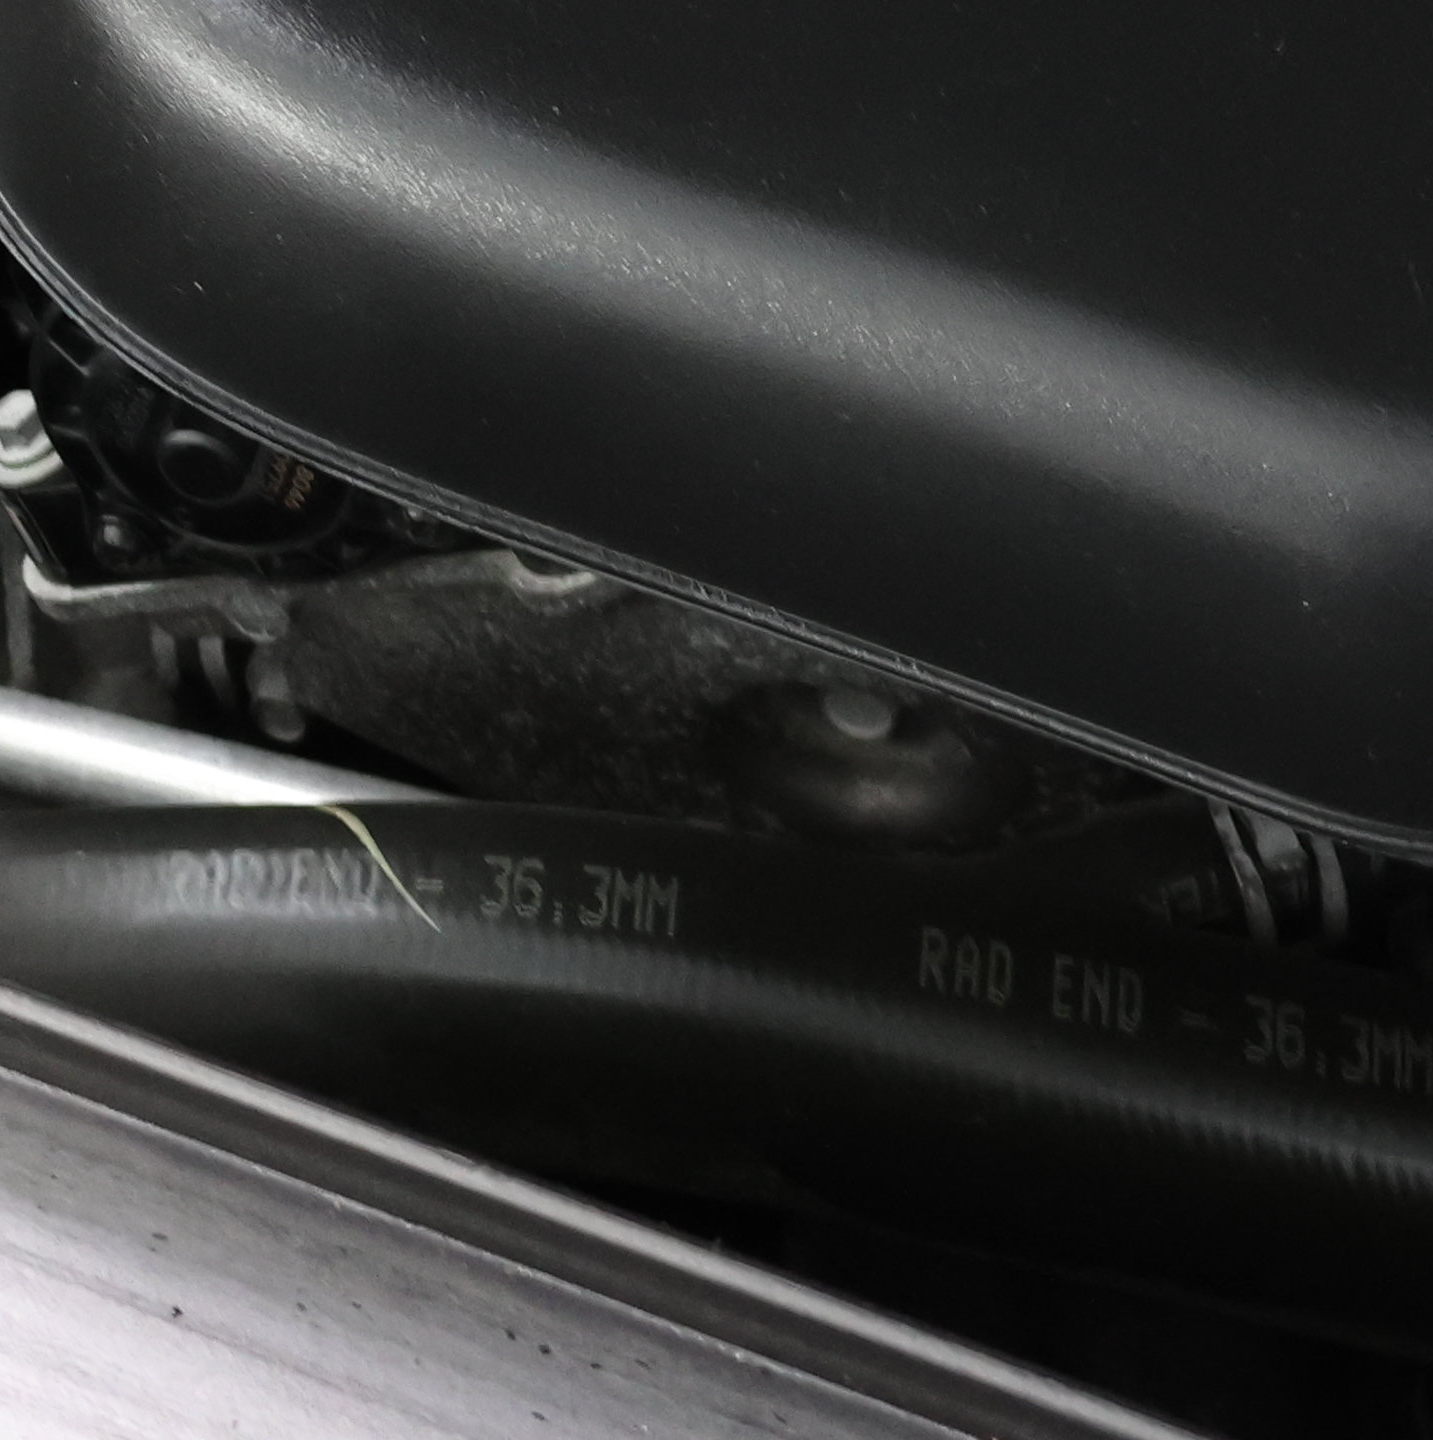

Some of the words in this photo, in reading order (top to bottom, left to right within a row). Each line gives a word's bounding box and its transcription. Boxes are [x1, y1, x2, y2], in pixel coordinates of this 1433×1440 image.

[481, 854, 680, 937] 36.3MM
[918, 923, 1013, 1008] RAD
[1051, 954, 1144, 1034] END
